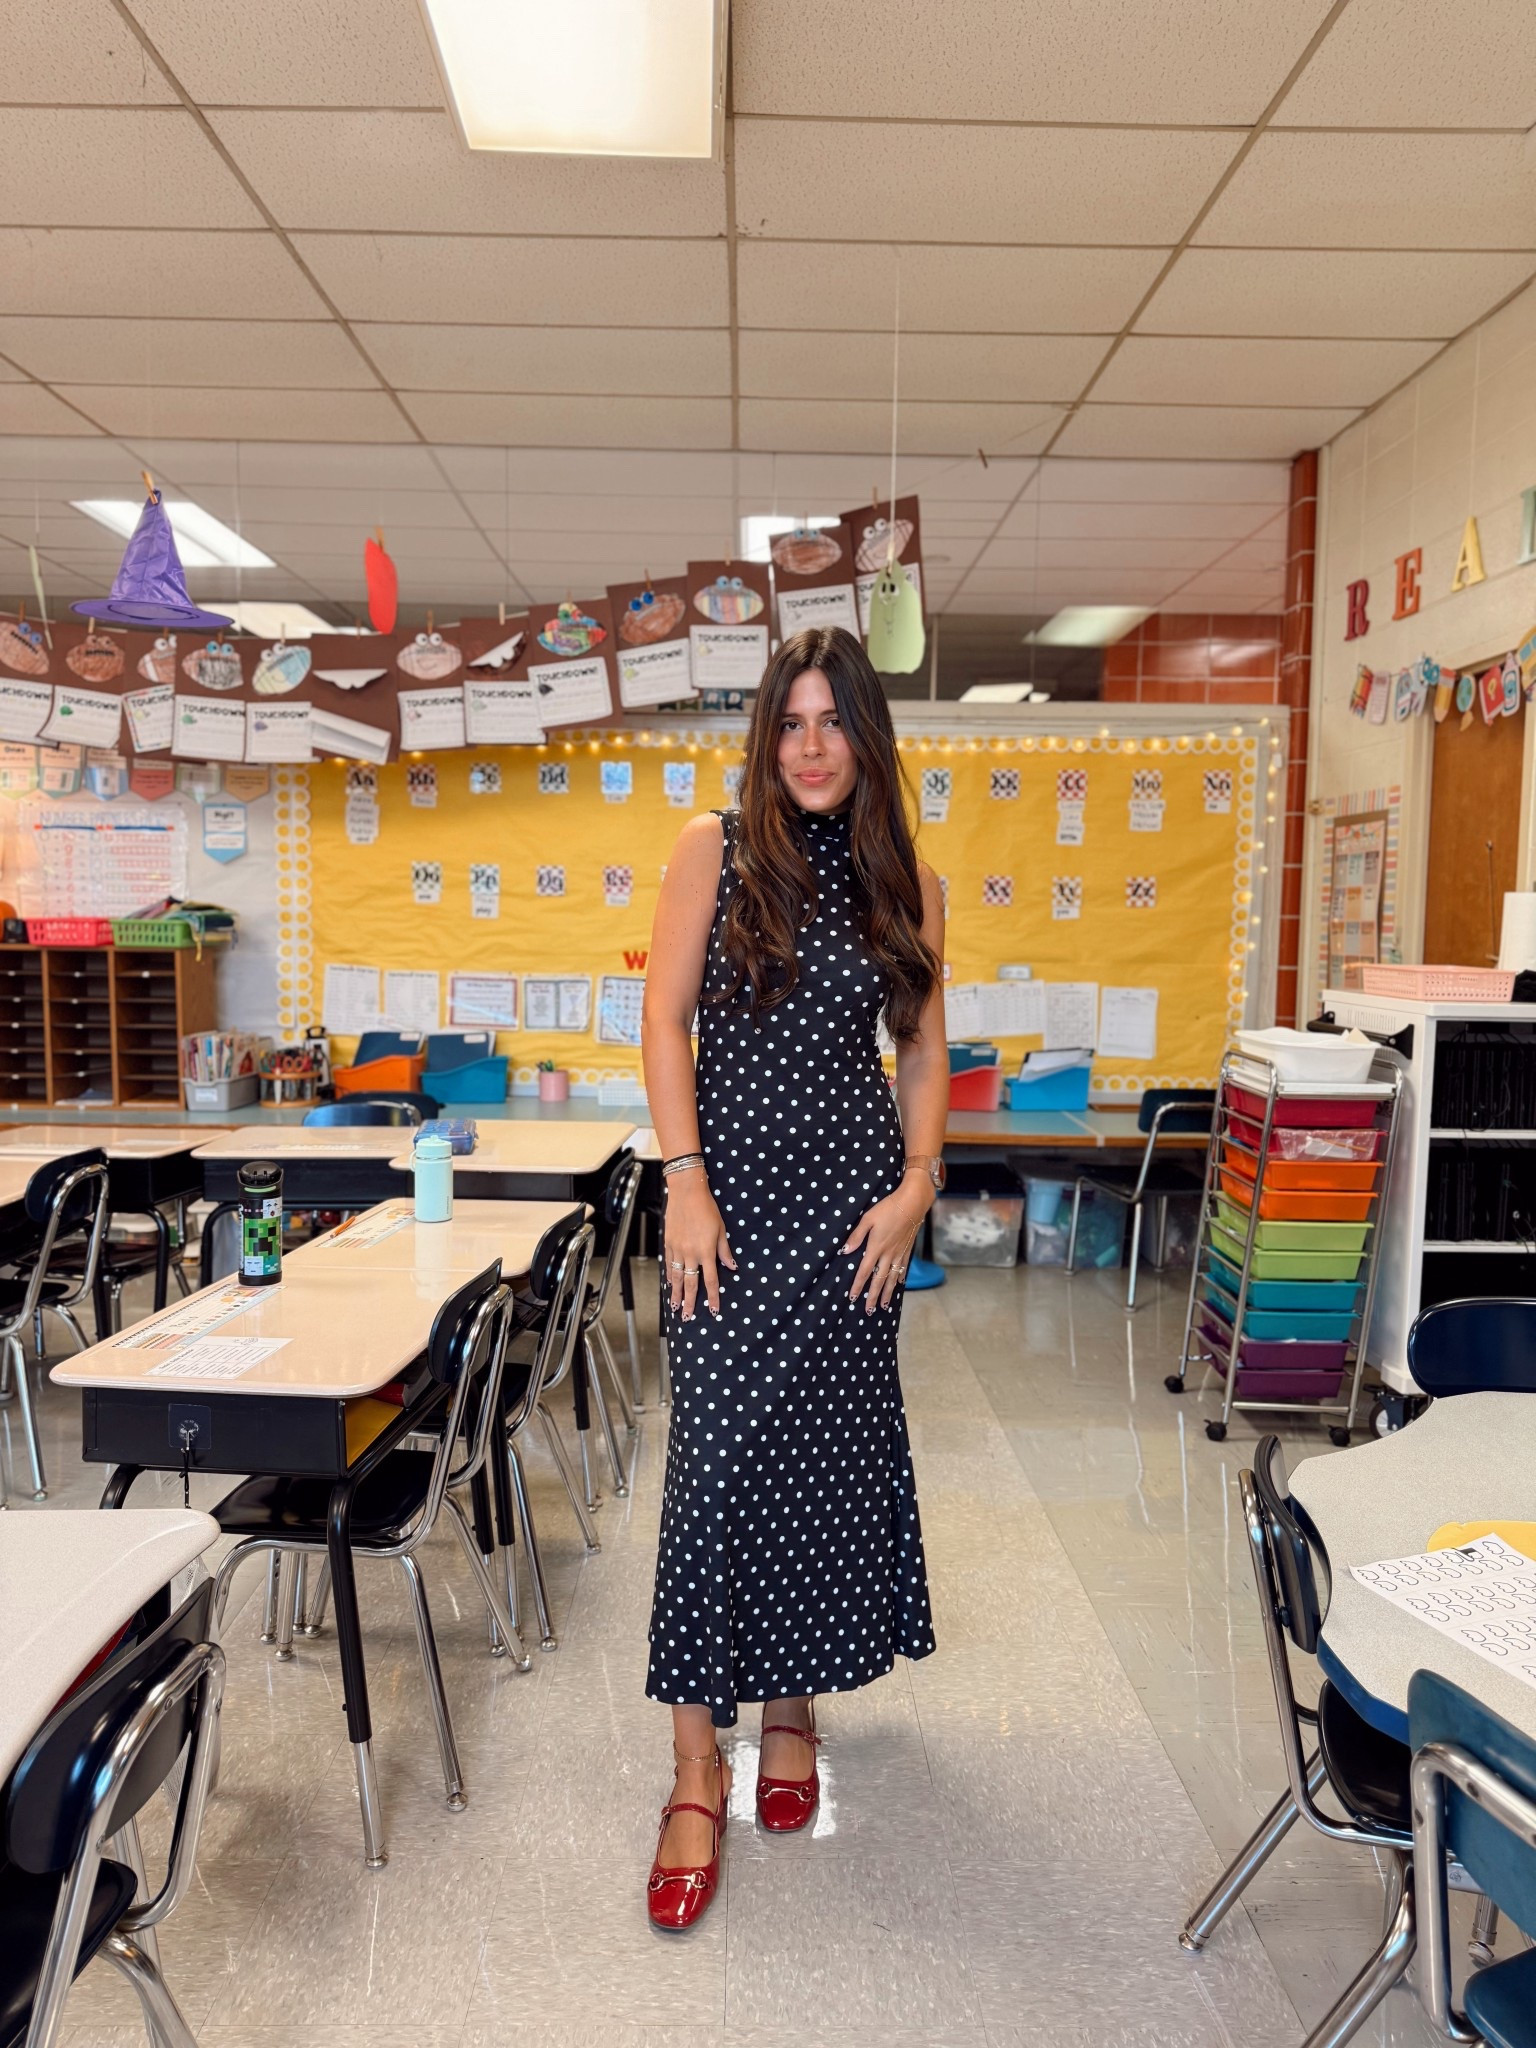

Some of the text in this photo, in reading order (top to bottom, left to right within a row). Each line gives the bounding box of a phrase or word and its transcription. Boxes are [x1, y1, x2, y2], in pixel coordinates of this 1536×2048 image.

[786, 594, 847, 608] TOUCHDOWN!
[698, 633, 760, 644] TOUCHDOWN!
[623, 649, 683, 666] TOUCHDOWN!
[537, 667, 598, 681] TOUCHDOWN!
